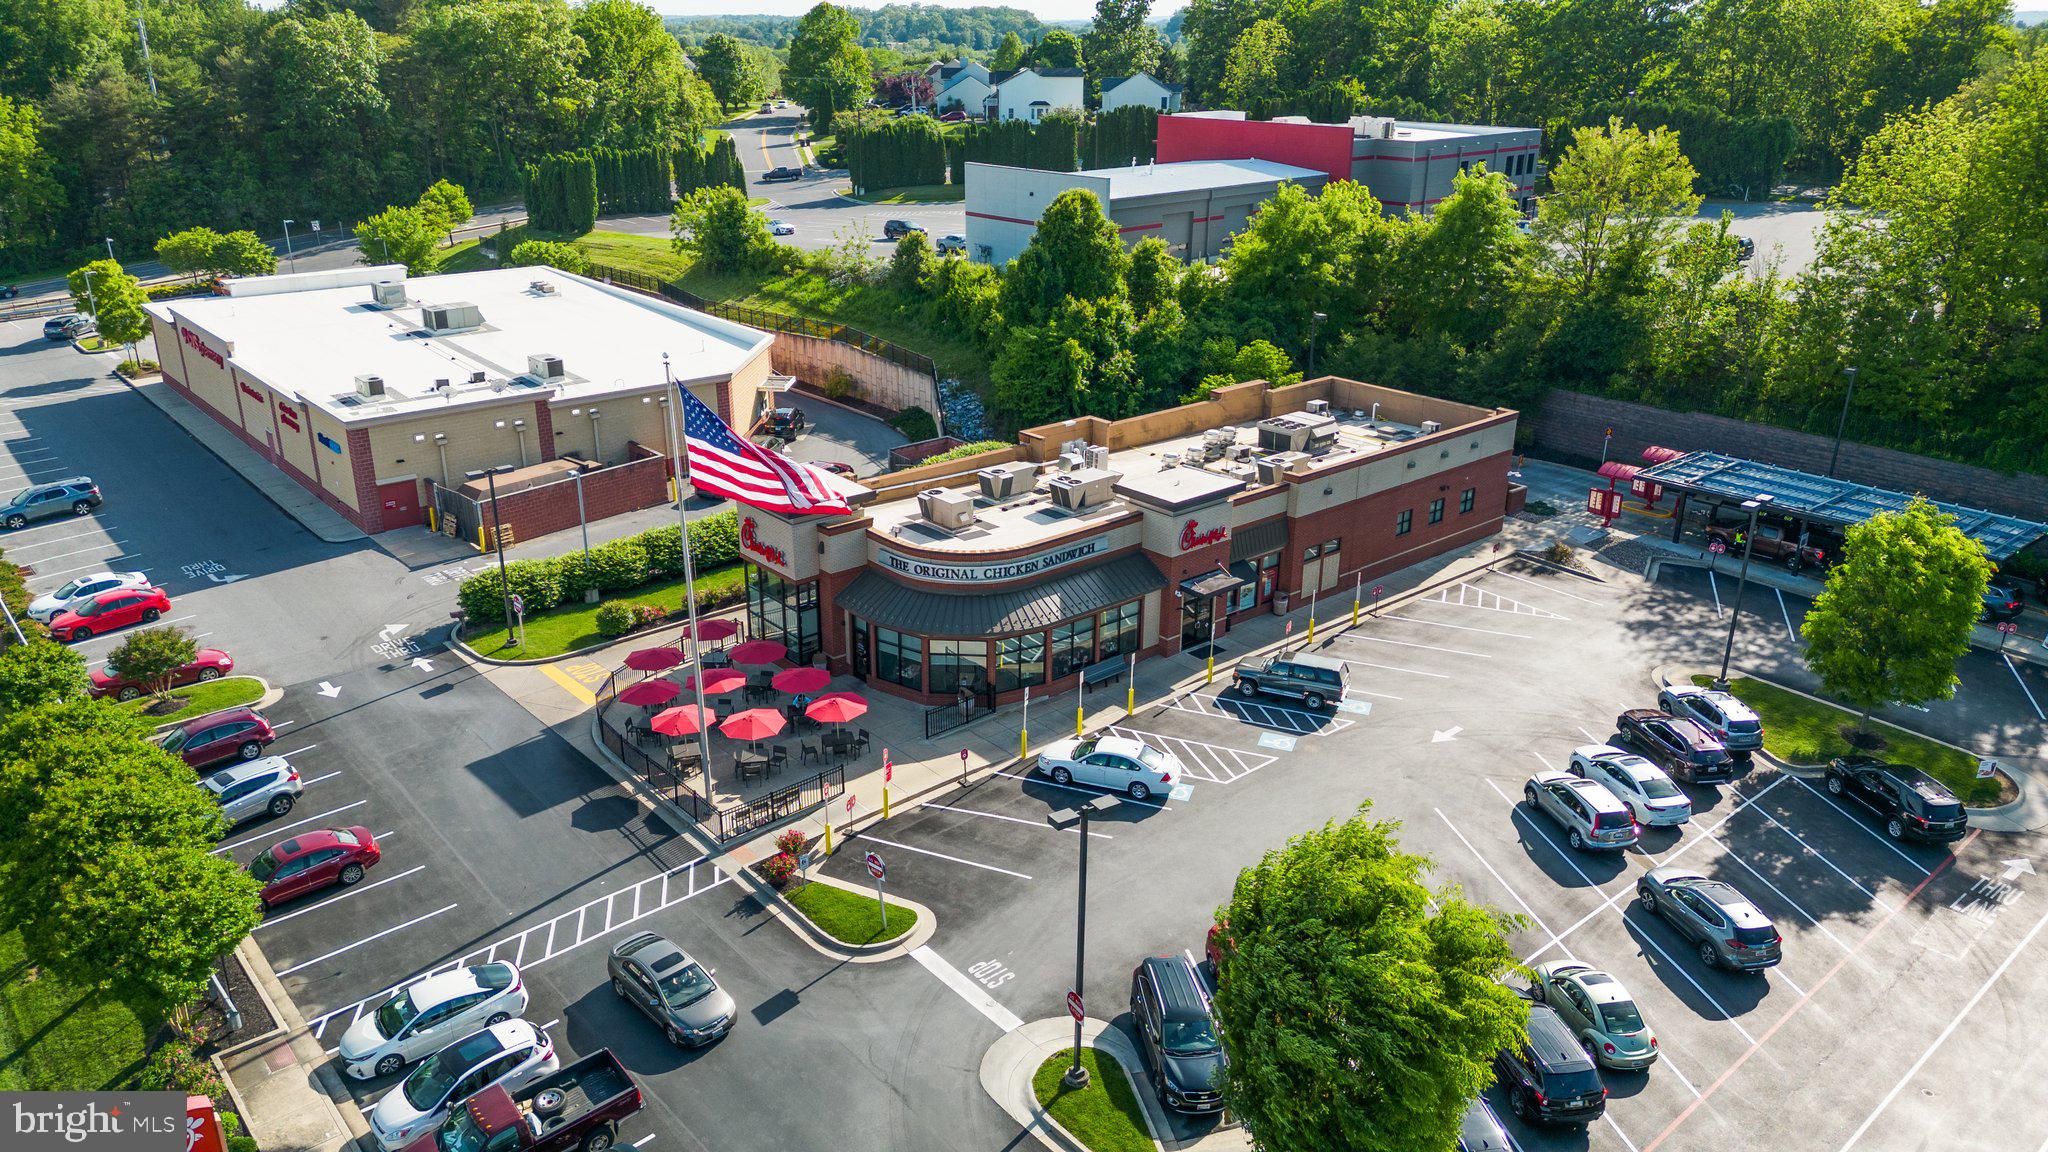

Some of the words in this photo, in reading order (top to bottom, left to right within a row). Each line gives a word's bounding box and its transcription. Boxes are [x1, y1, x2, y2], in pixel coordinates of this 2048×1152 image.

[180, 560, 218, 573] THRU
[185, 564, 226, 579] DRIVE
[889, 556, 909, 572] THE
[914, 564, 978, 580] ORIGINAL
[984, 560, 1039, 579] CHICKEN
[1043, 542, 1096, 566] SANDWICH
[370, 636, 412, 654] DRIVE
[380, 642, 421, 660] THRU
[1970, 874, 2025, 906] THRU
[1950, 892, 2006, 925] LANE
[967, 959, 1016, 989] STOP
